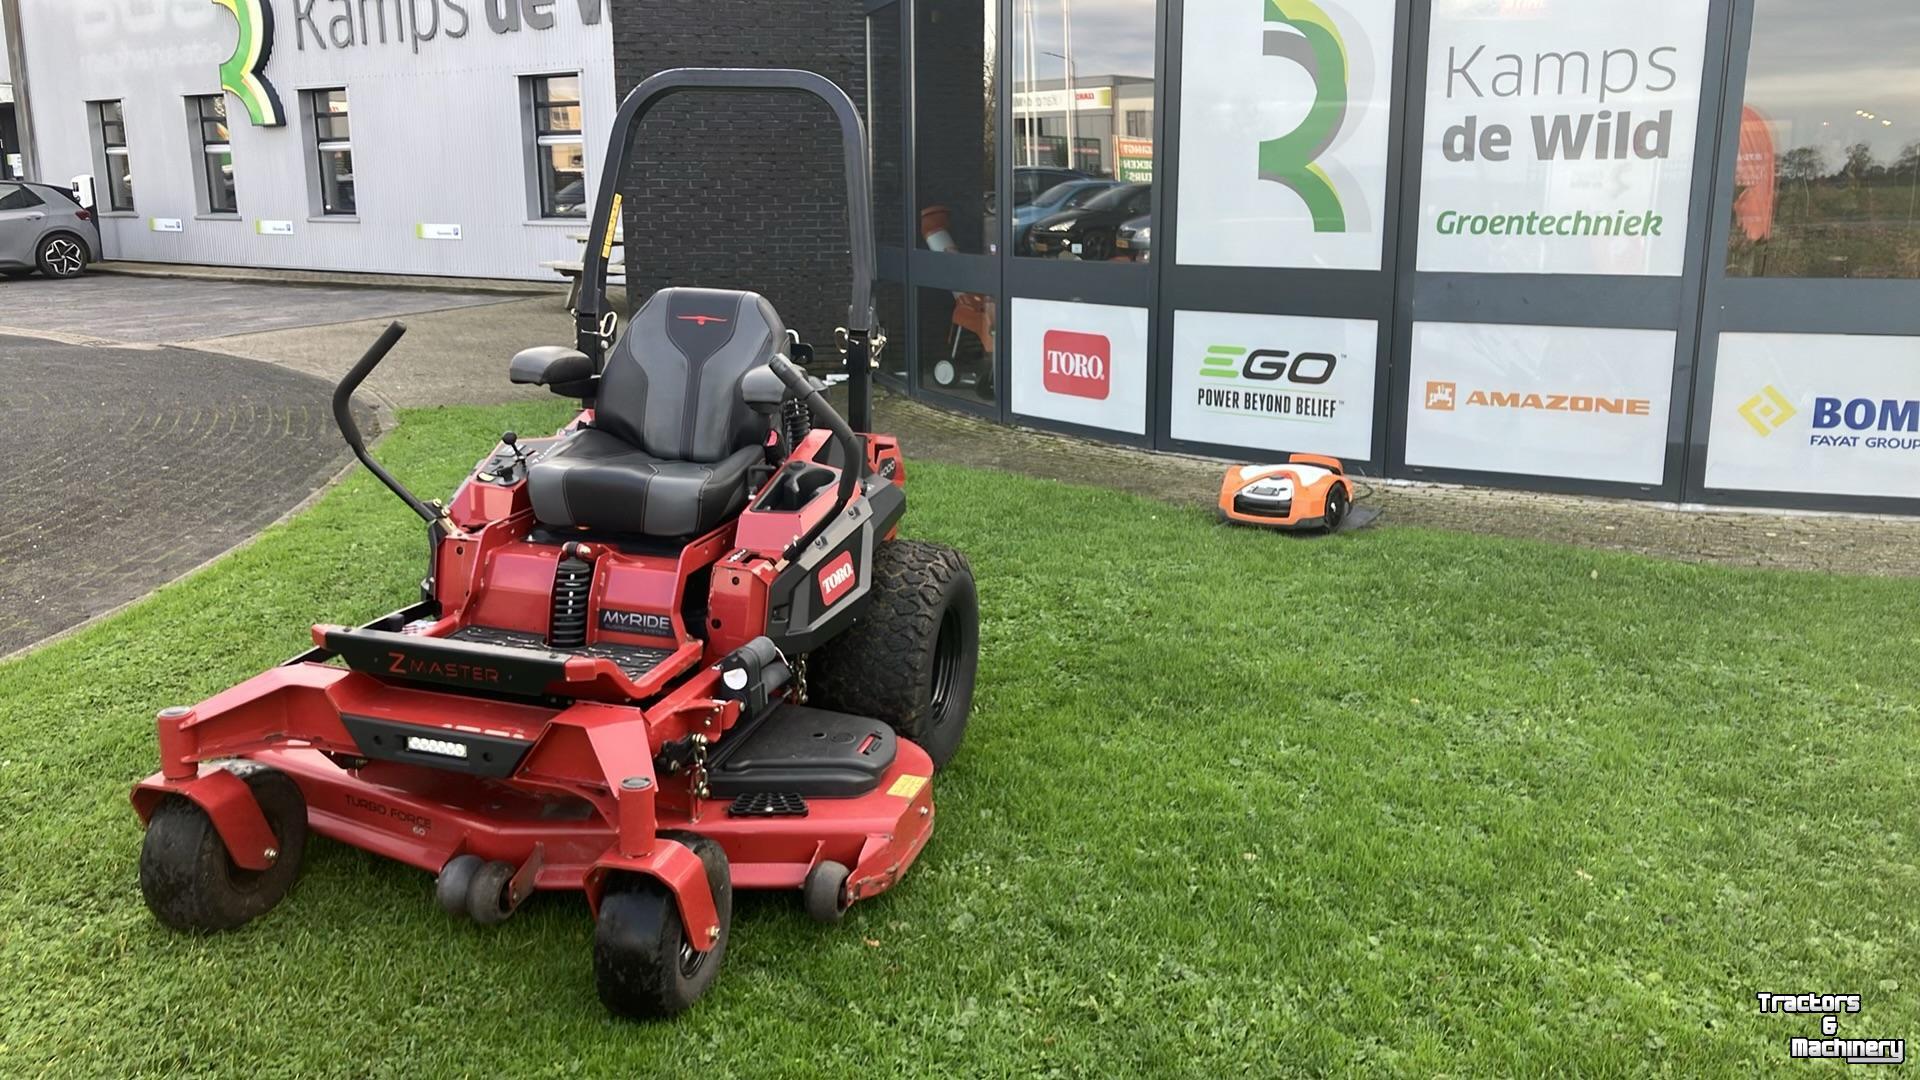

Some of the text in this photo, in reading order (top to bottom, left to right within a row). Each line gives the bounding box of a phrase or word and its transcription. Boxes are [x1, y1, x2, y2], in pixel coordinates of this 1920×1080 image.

[293, 0, 469, 54] Kamps
[1447, 45, 1677, 103] Kamps
[1442, 109, 1673, 162] de Wild
[1436, 210, 1663, 236] Groentechniek
[1198, 388, 1336, 418] POWER BEYOND BELIEF
[1466, 390, 1650, 416] AMAZONE
[1810, 434, 1860, 447] FAYAT
[388, 652, 499, 682] Z MASTER
[344, 794, 431, 828] TURBO FORCE
